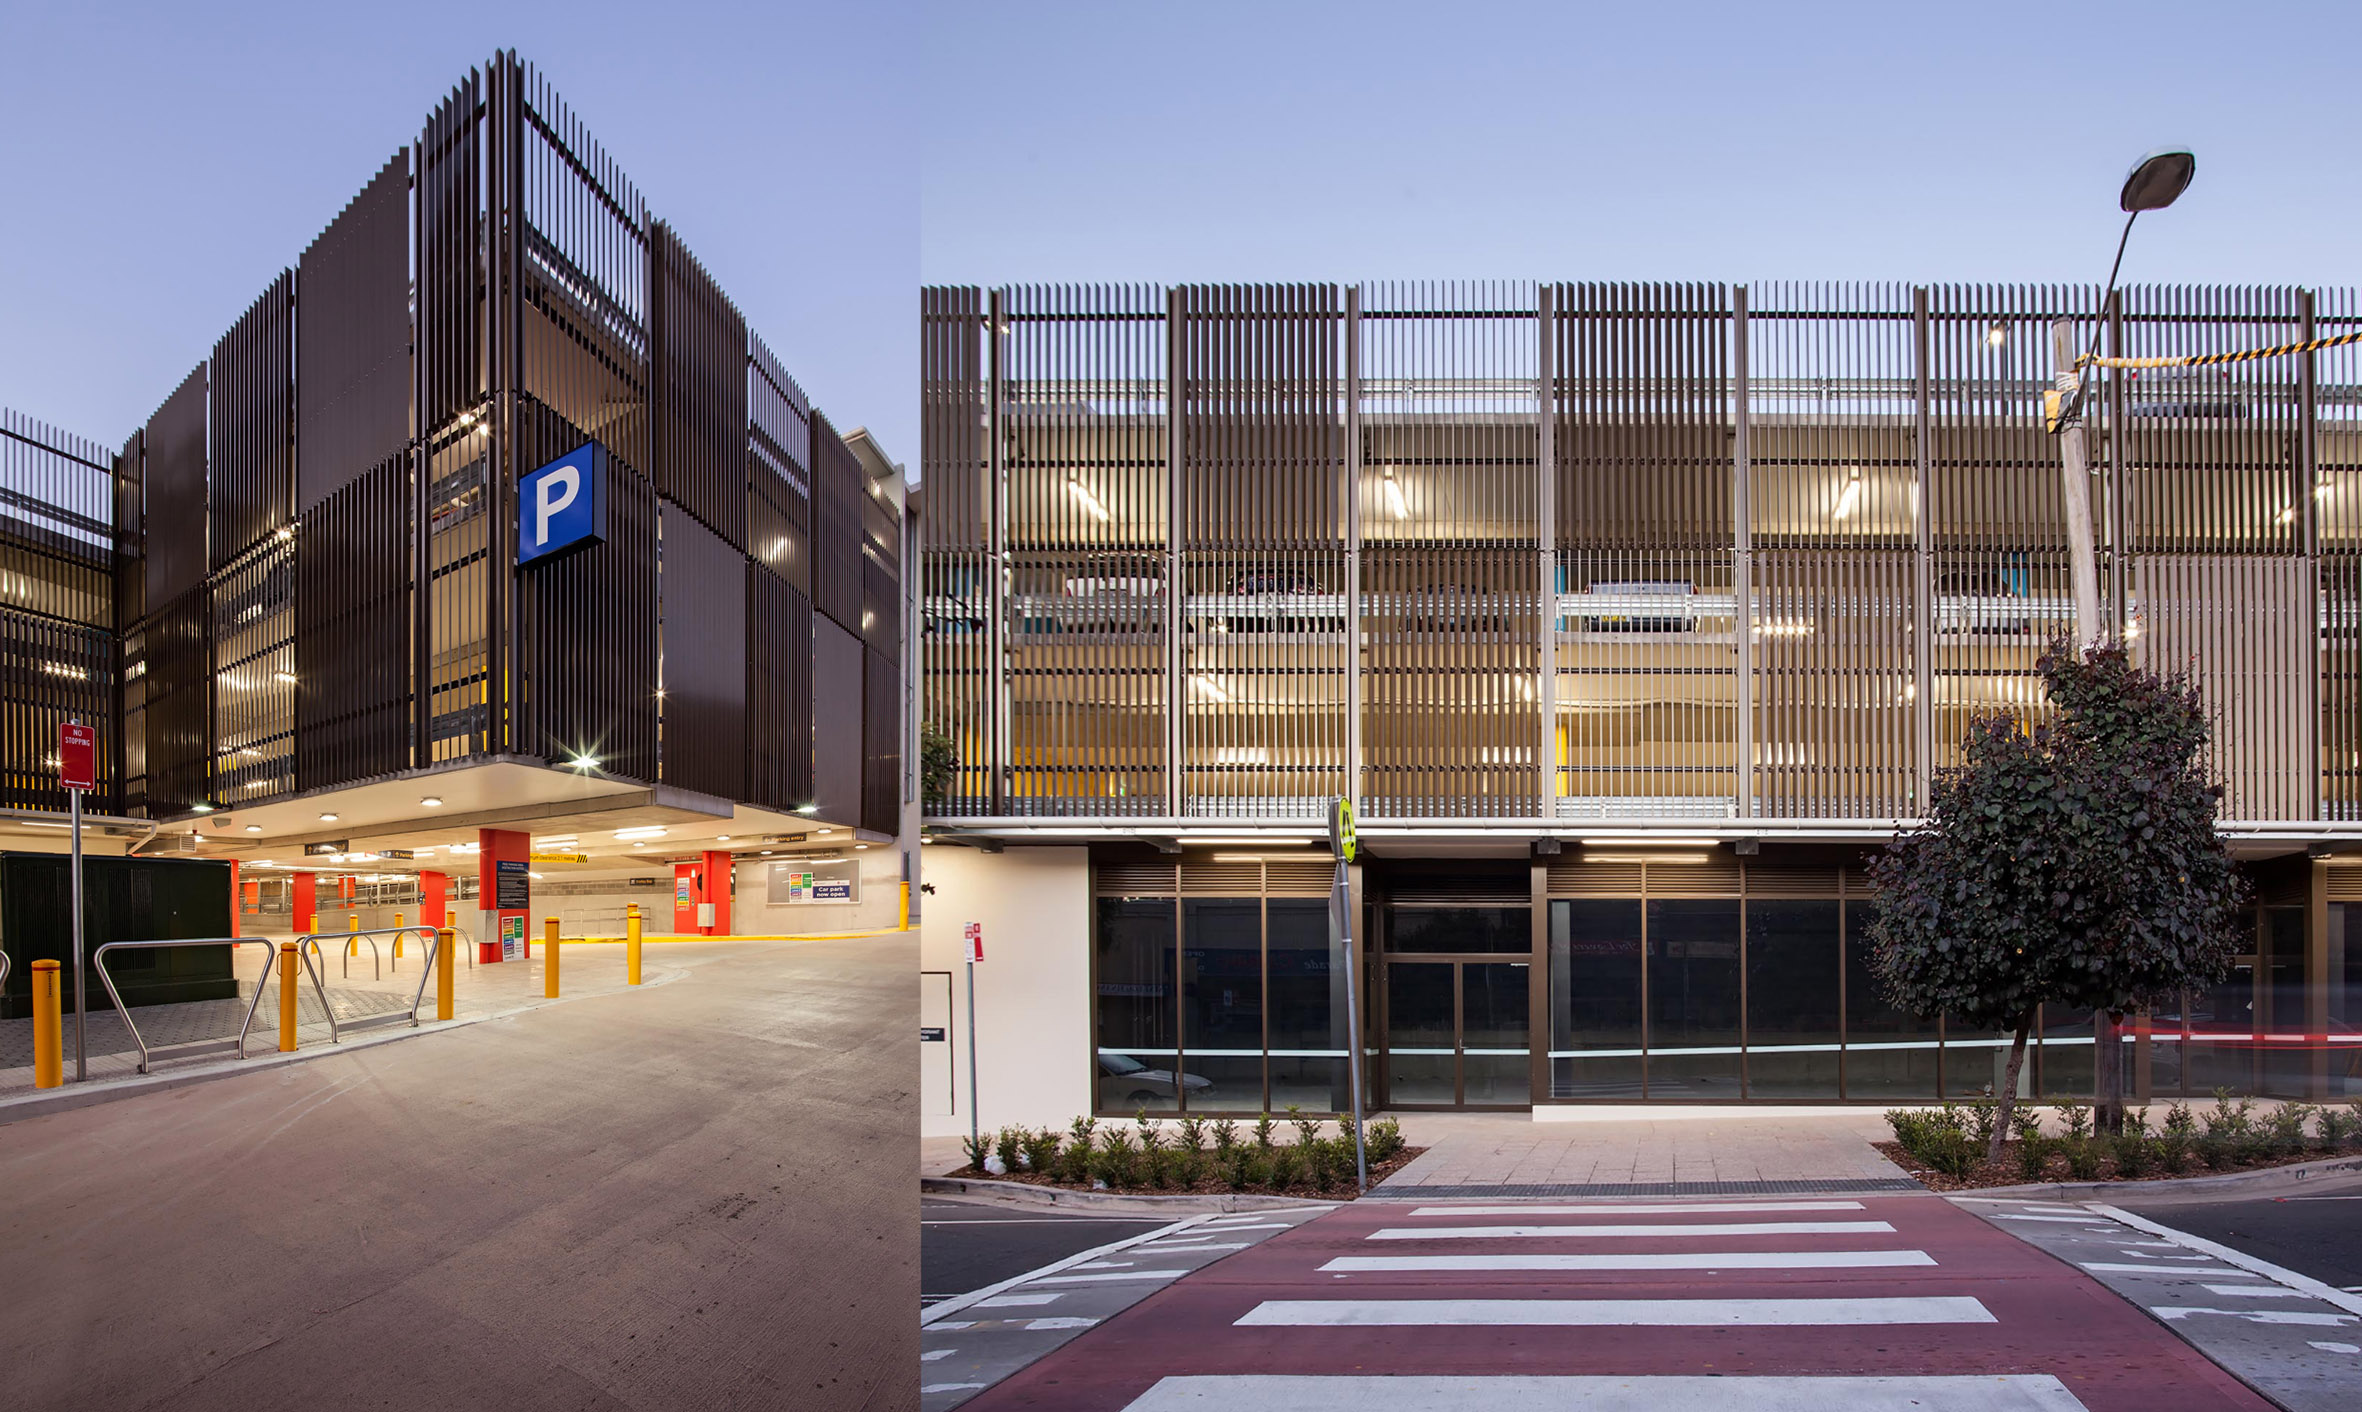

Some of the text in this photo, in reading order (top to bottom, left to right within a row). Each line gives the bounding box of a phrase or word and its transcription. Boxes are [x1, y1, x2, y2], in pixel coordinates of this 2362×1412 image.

[536, 465, 580, 547] P
[72, 729, 83, 737] NO
[64, 736, 91, 747] STOPPING
